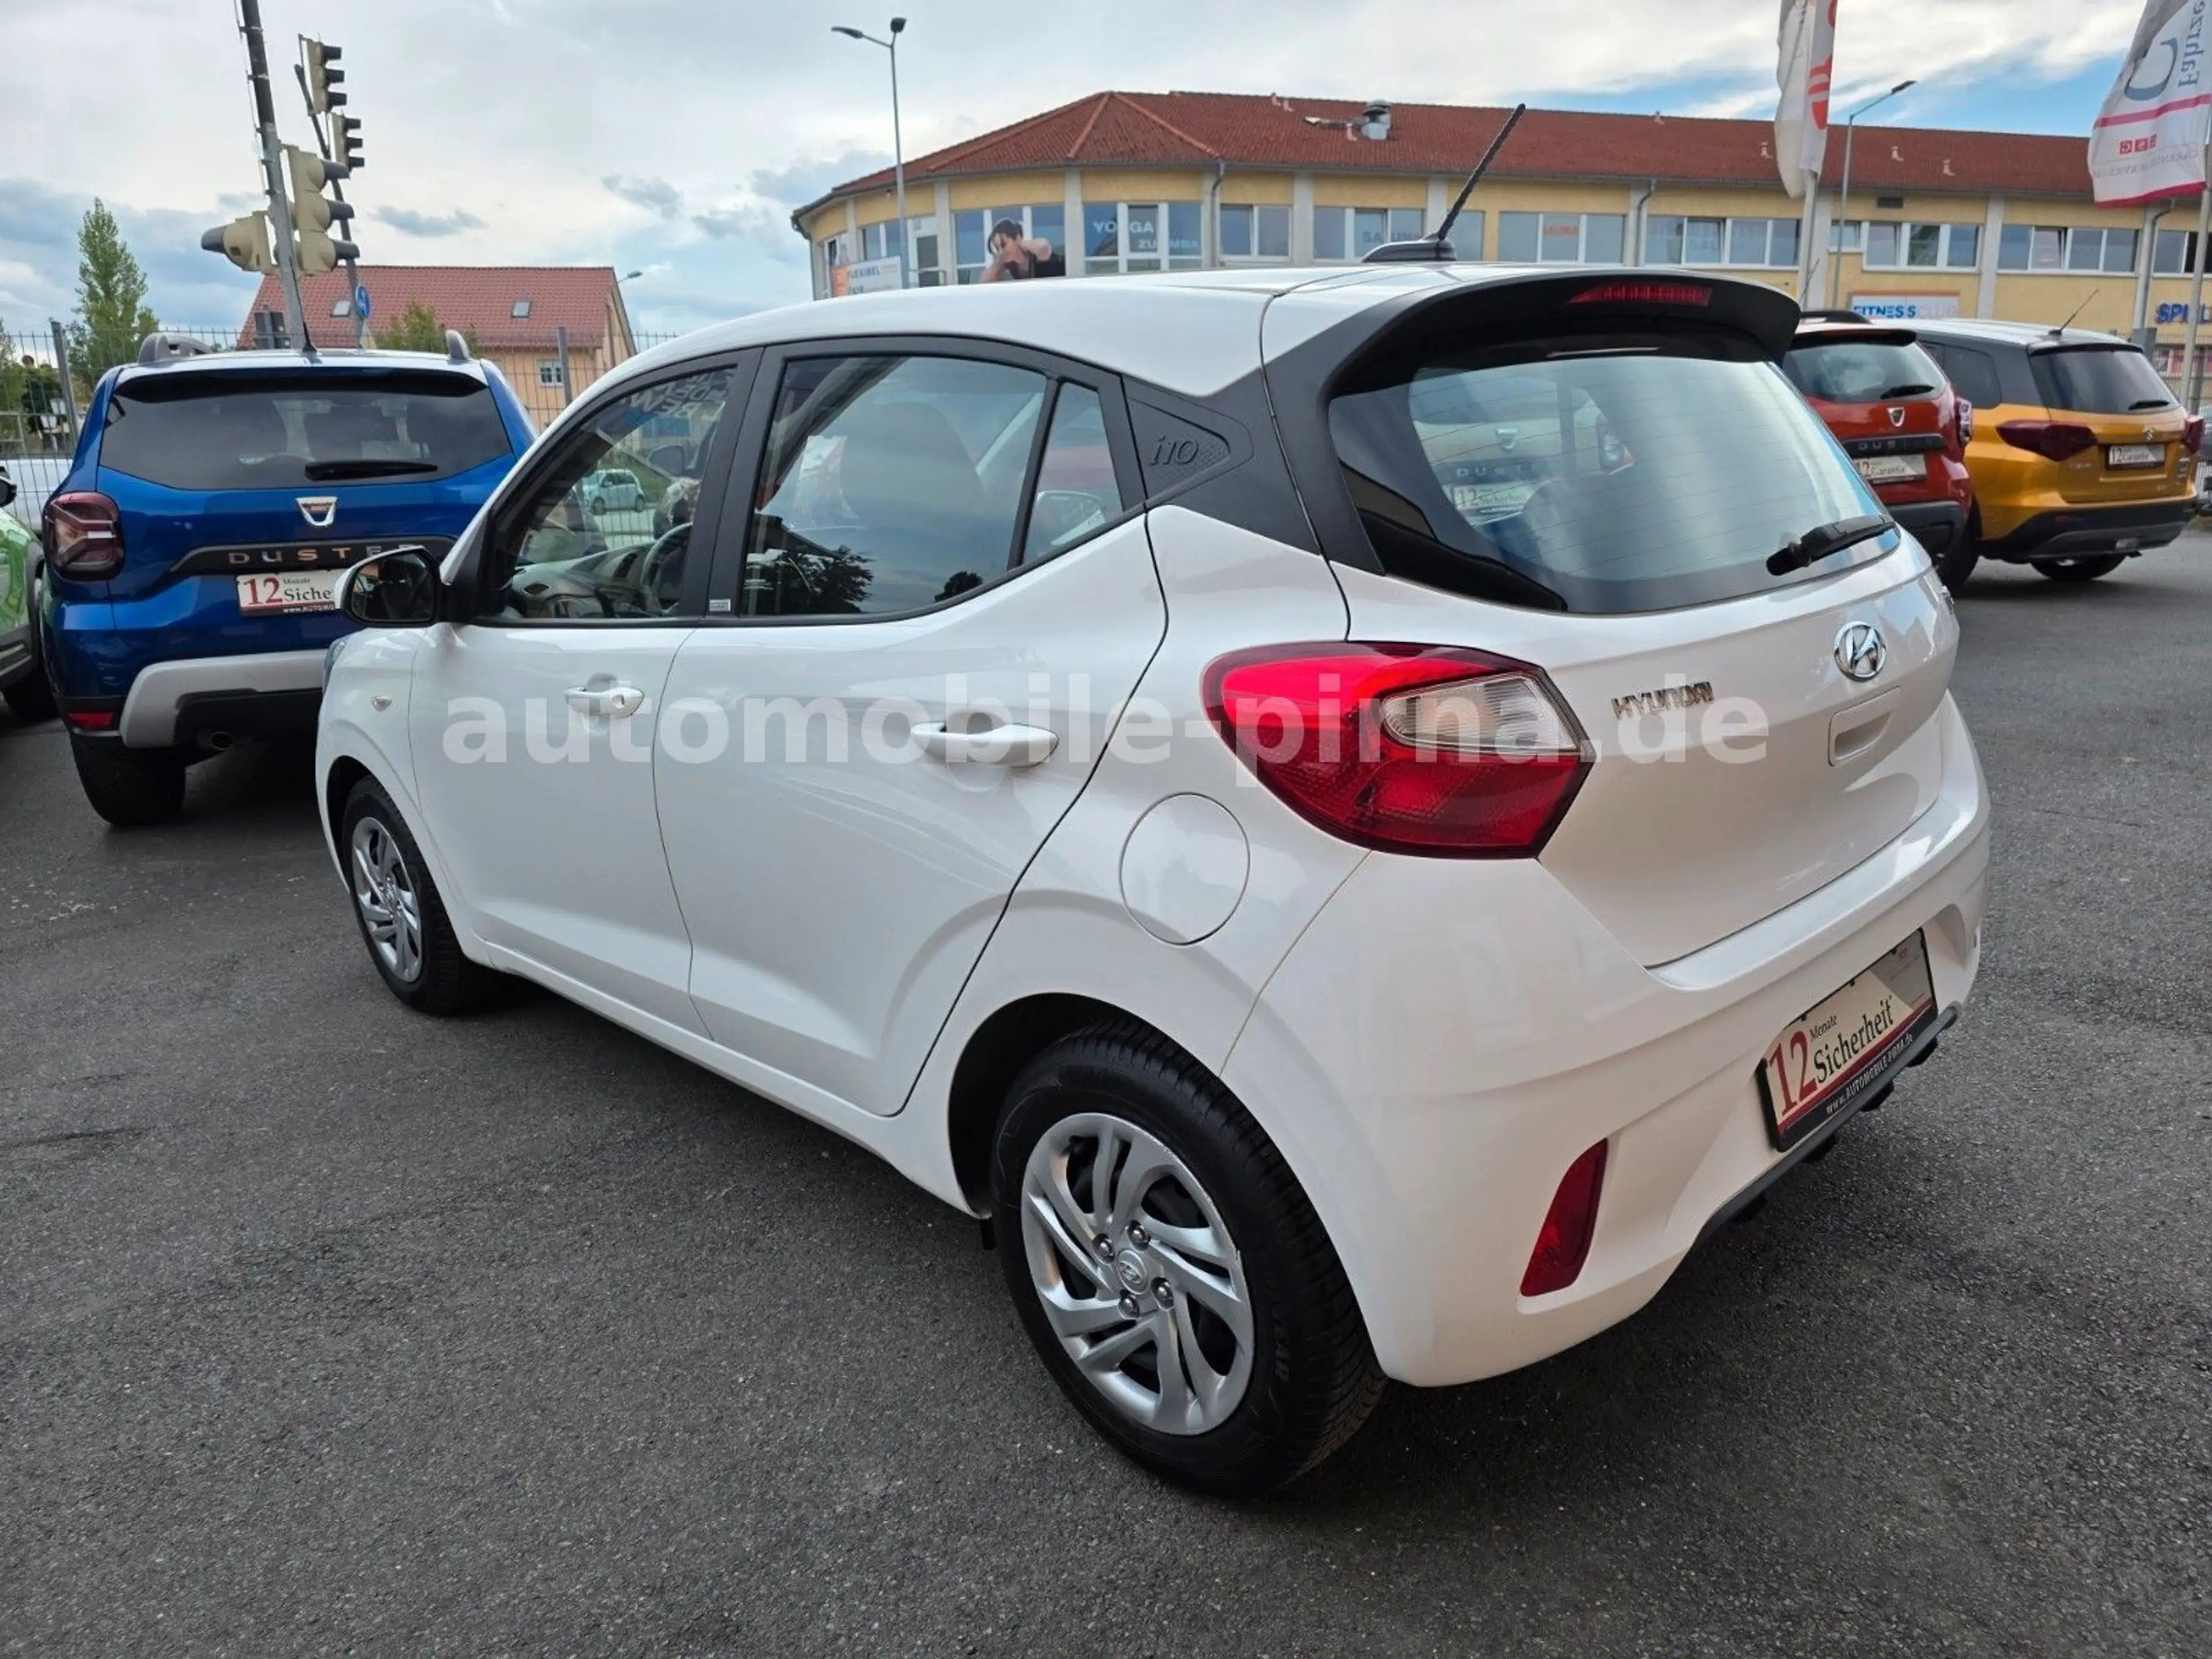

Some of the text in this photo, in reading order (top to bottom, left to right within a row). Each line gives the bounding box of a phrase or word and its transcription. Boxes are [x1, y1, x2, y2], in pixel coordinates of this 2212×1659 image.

[1093, 221, 1155, 233] YOGA
[1137, 238, 1199, 249] ZUMBA
[1854, 305, 1916, 319] FITNESS
[2156, 303, 2212, 324] SPIL
[1149, 433, 1199, 466] i10
[2111, 447, 2122, 463] 12
[229, 544, 425, 565] DUSTE
[243, 577, 283, 605] 12
[283, 586, 332, 603] Siche
[1611, 681, 1714, 720] HYUNDAI
[1809, 1014, 1838, 1041] Monate
[1814, 998, 1894, 1084] Sicherheit
[1769, 1031, 1817, 1116] 12
